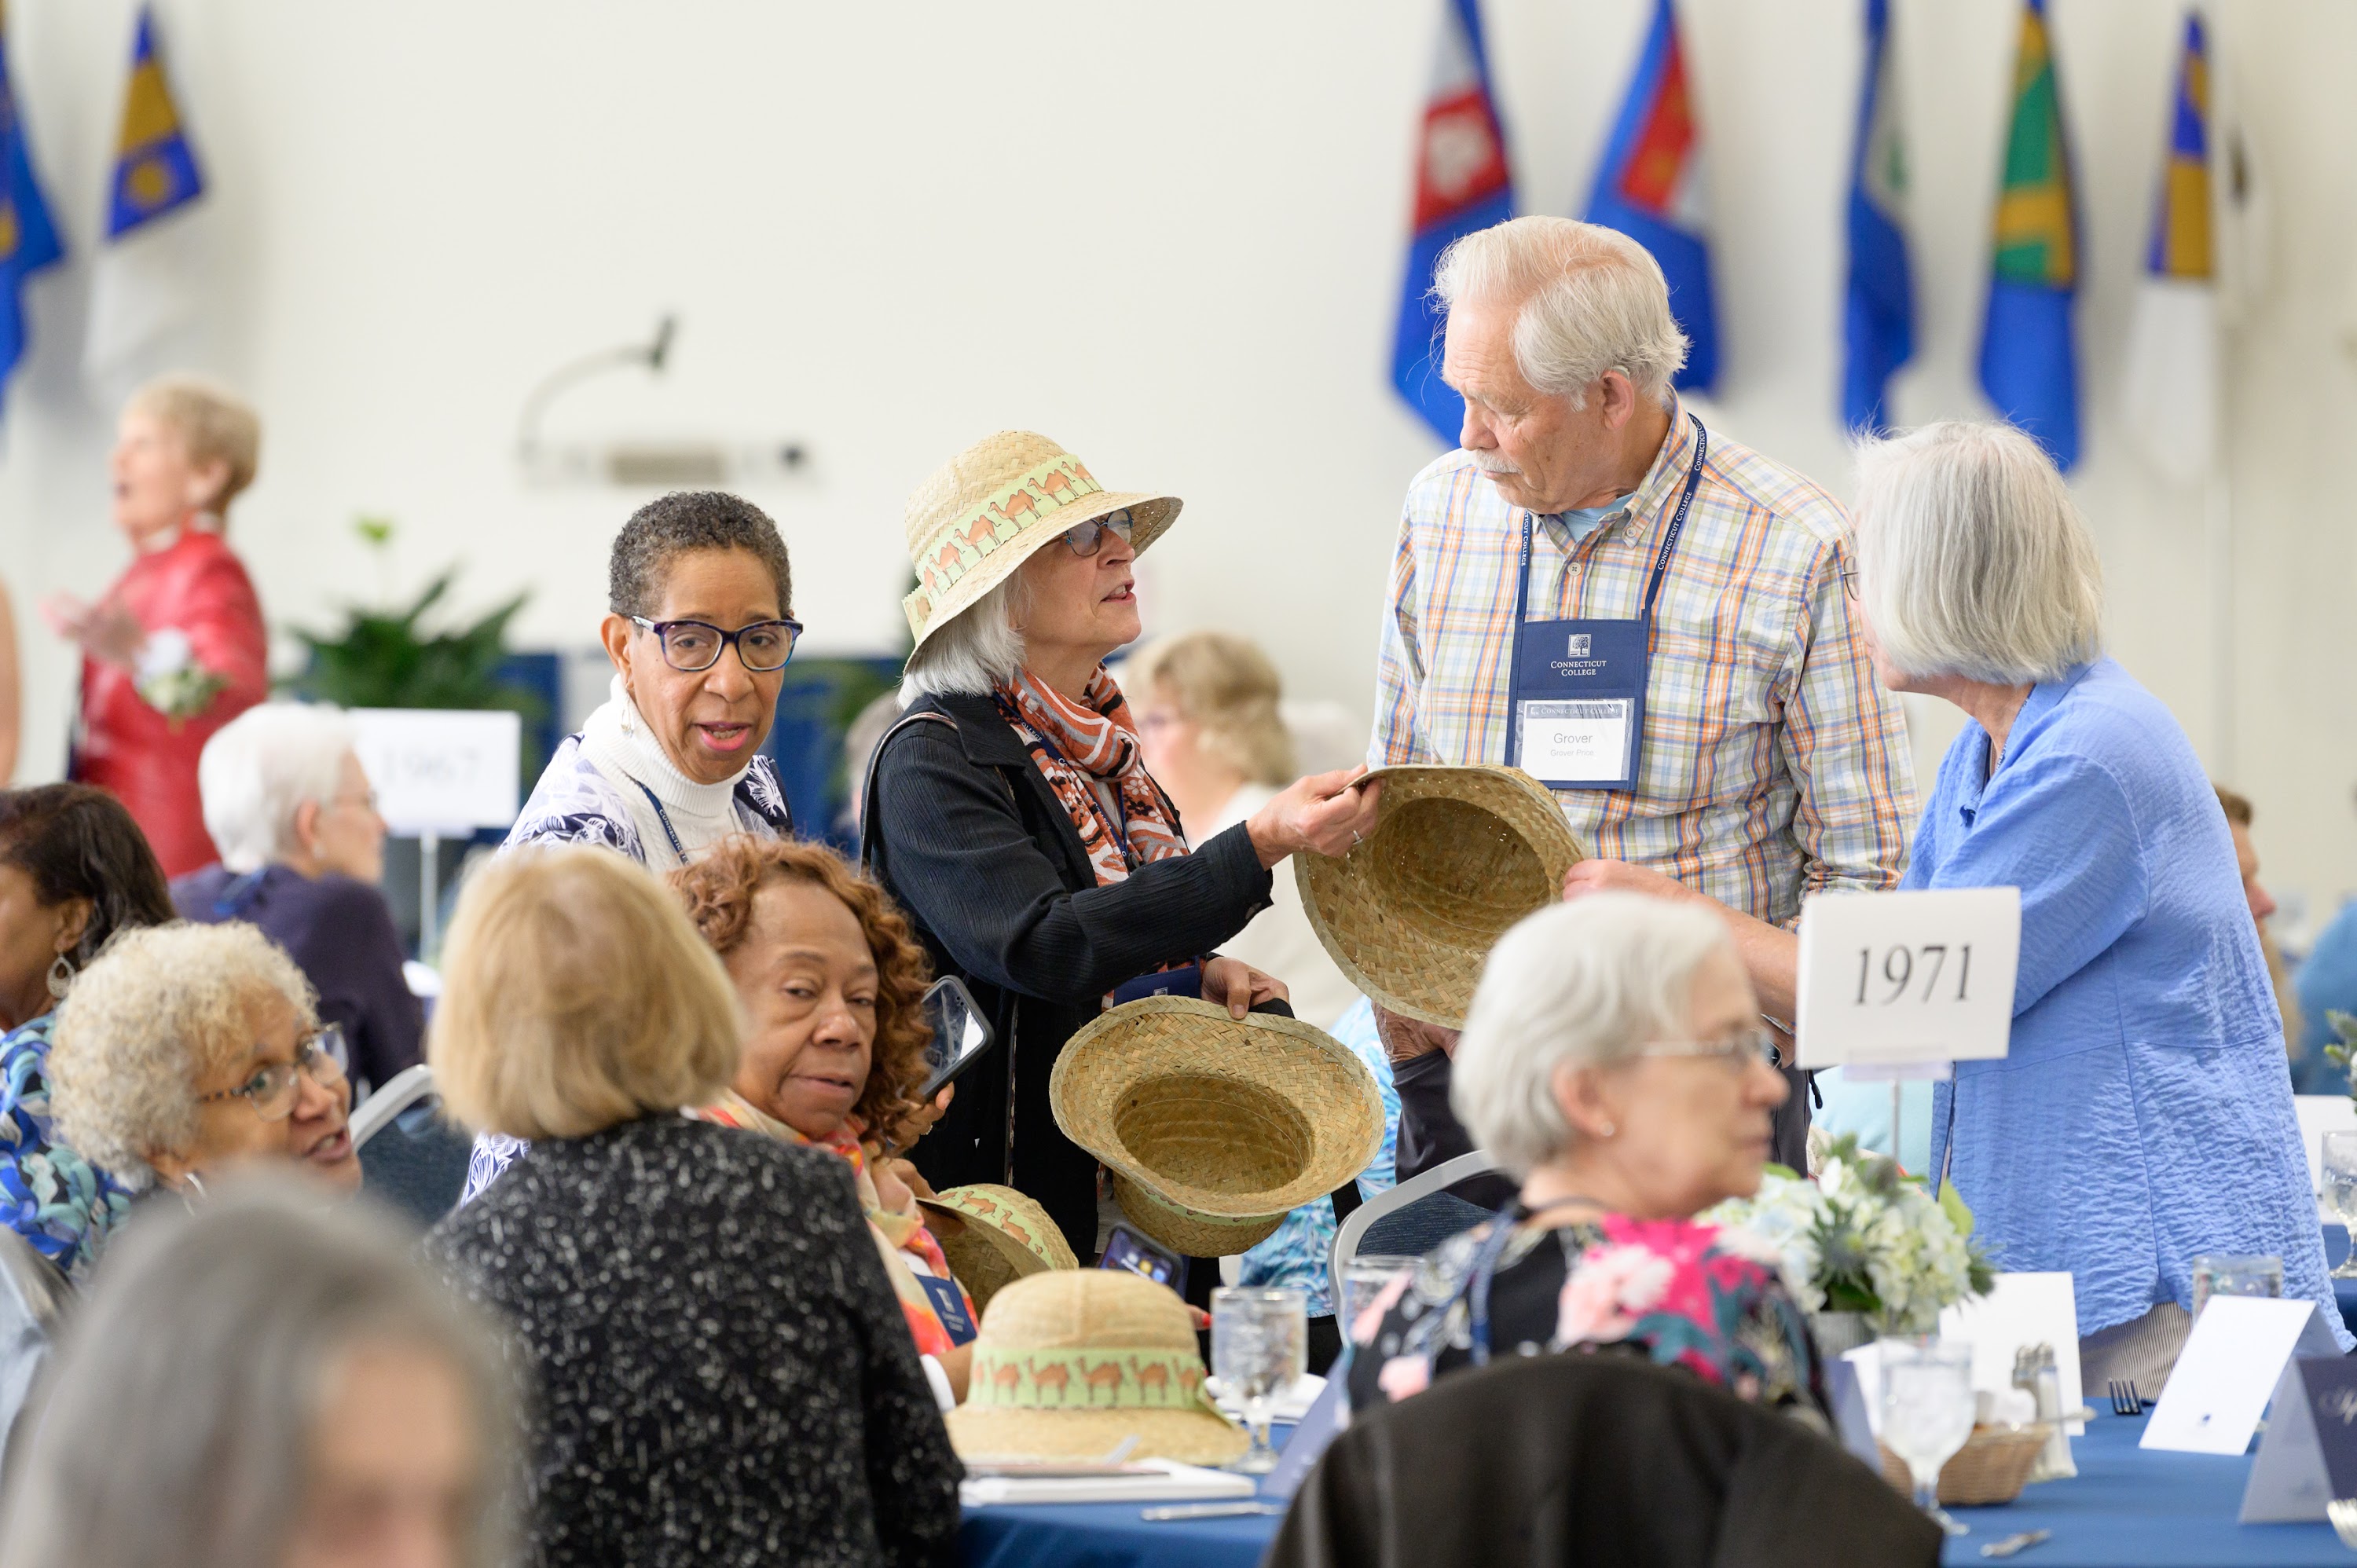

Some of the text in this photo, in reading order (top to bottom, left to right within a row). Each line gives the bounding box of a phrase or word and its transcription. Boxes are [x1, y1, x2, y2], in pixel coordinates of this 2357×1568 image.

[1658, 522, 1680, 570] CONNECTICUT
[1676, 491, 1692, 522] COLLEGE
[1553, 733, 1593, 744] Grover
[1854, 944, 1971, 1006] 1971
